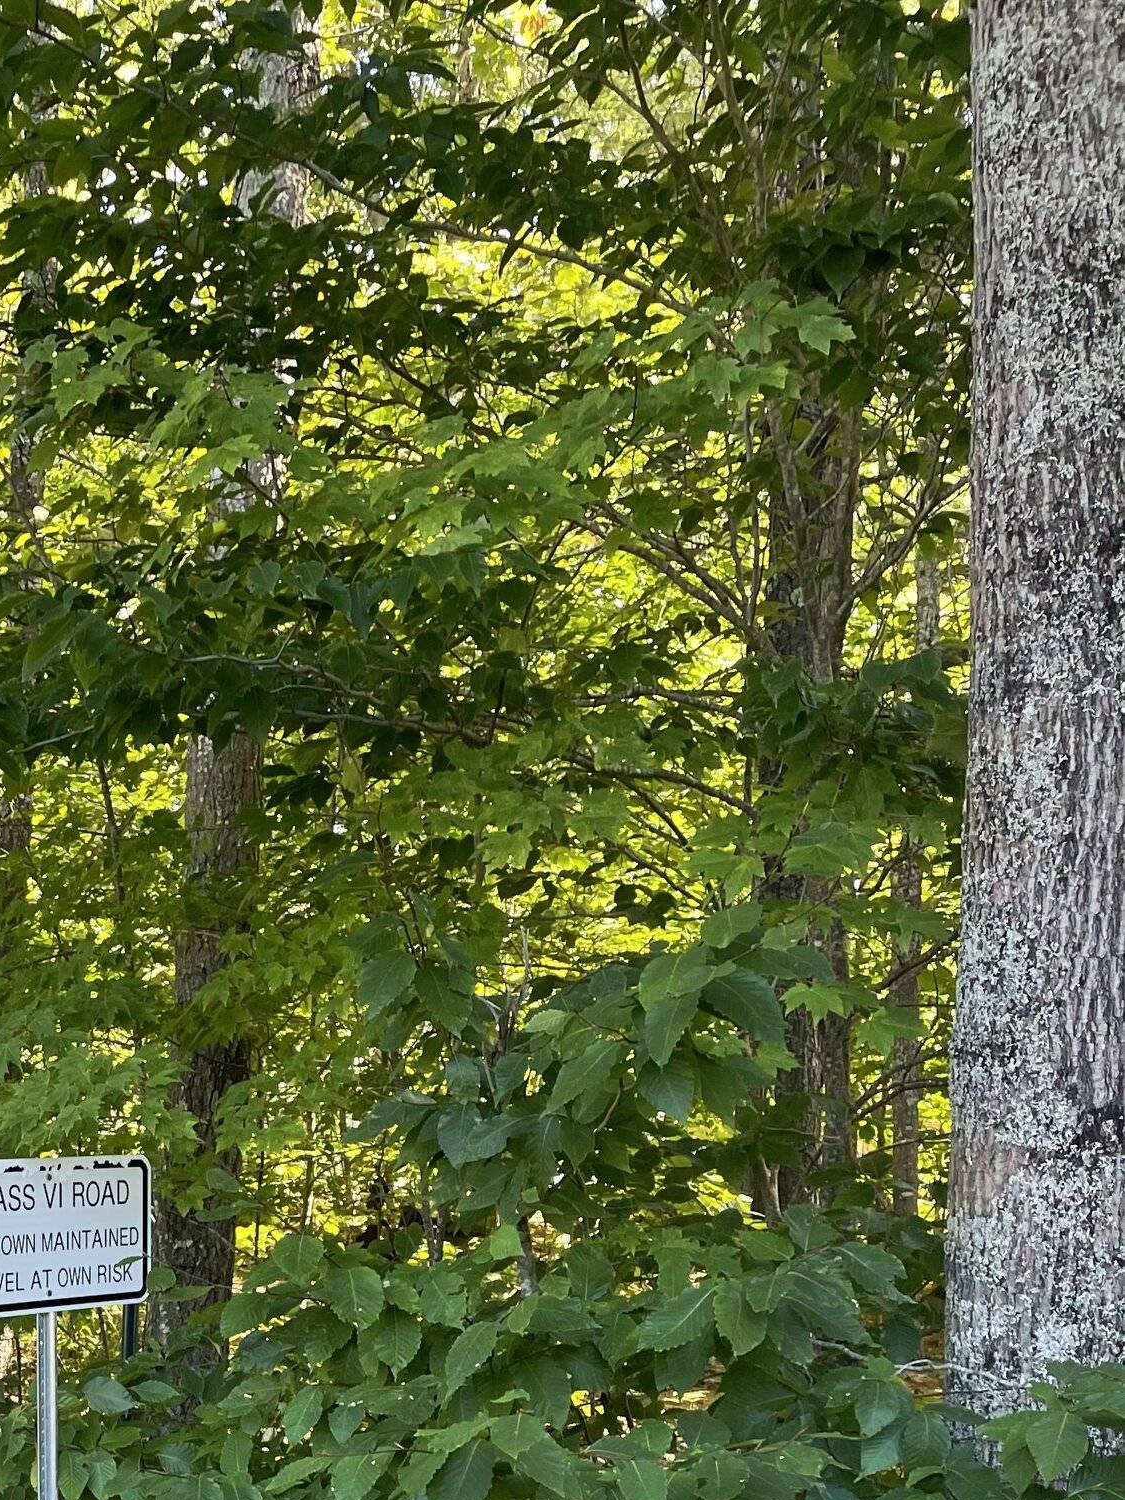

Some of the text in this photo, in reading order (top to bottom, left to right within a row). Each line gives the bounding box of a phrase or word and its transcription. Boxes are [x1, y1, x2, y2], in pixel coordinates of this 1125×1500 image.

[43, 1182, 62, 1208] VI
[73, 1180, 130, 1207] ROAD
[42, 1227, 139, 1252] MAINTAINED
[31, 1269, 52, 1291] AT
[57, 1267, 91, 1287] OWN
[97, 1263, 133, 1284] RISK
